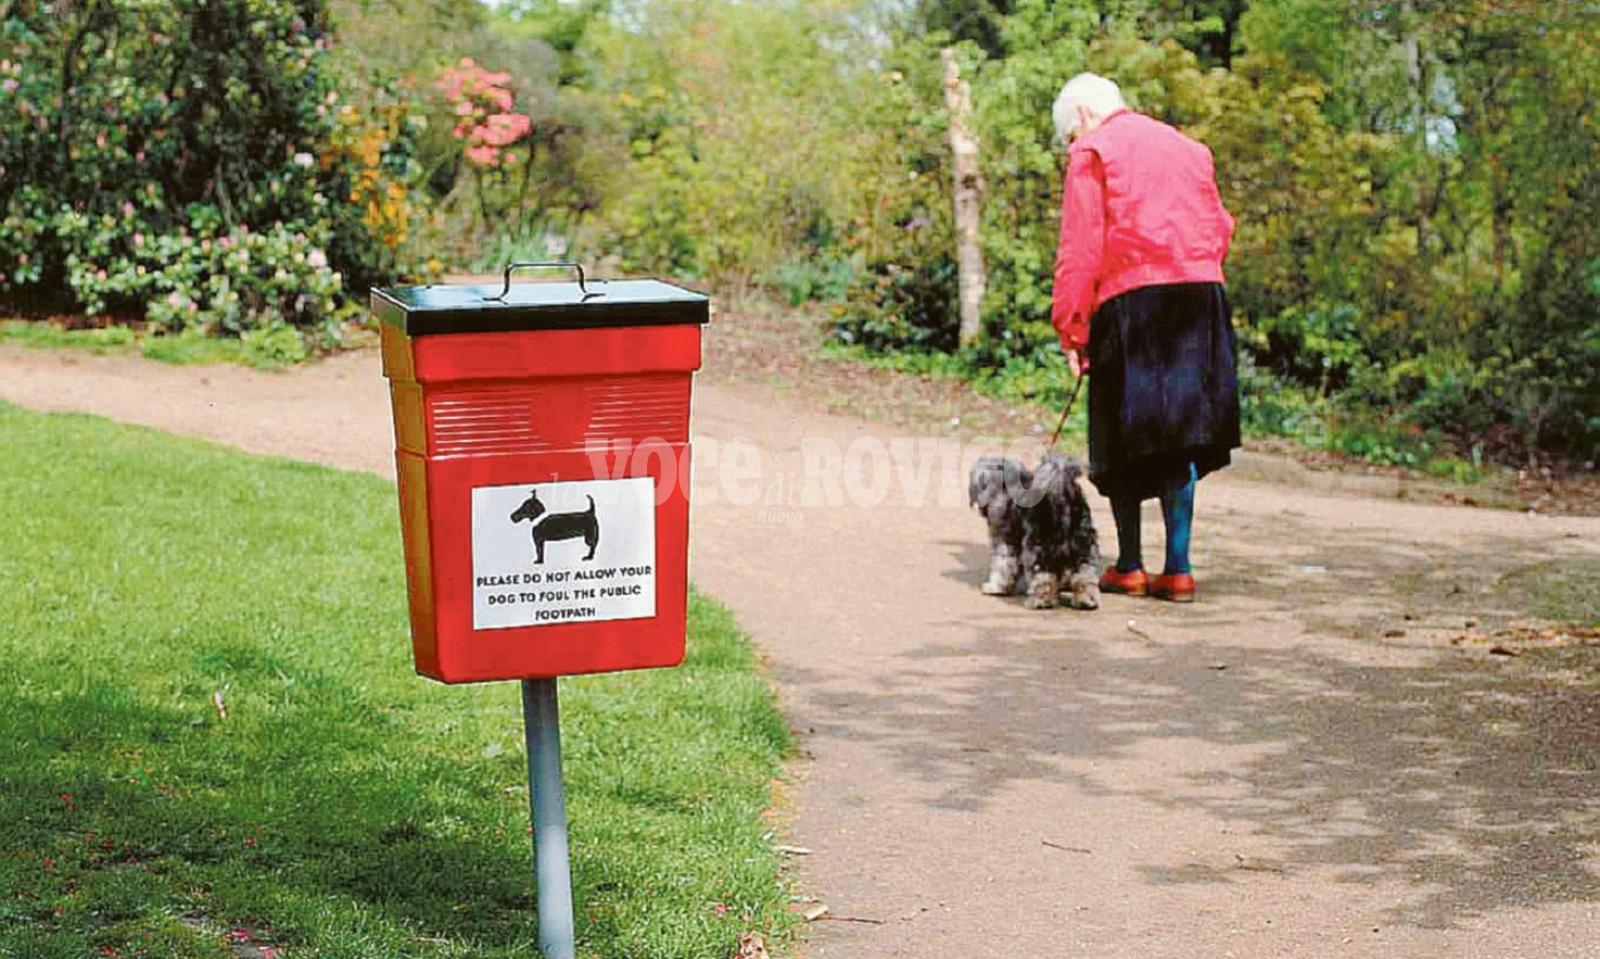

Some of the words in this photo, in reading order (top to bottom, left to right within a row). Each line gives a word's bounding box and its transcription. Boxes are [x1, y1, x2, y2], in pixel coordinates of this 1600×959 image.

[476, 574, 520, 587] PLEASE
[523, 572, 542, 584] DO
[546, 571, 571, 583] NOT
[574, 568, 617, 581] ALLOW
[619, 566, 652, 577] YOUR
[488, 594, 516, 605] DOG
[519, 592, 536, 603] TO
[539, 591, 570, 602] FOUL
[573, 588, 596, 599] THE
[599, 585, 642, 597] PUBLIC
[535, 607, 596, 621] FOOTPATH
